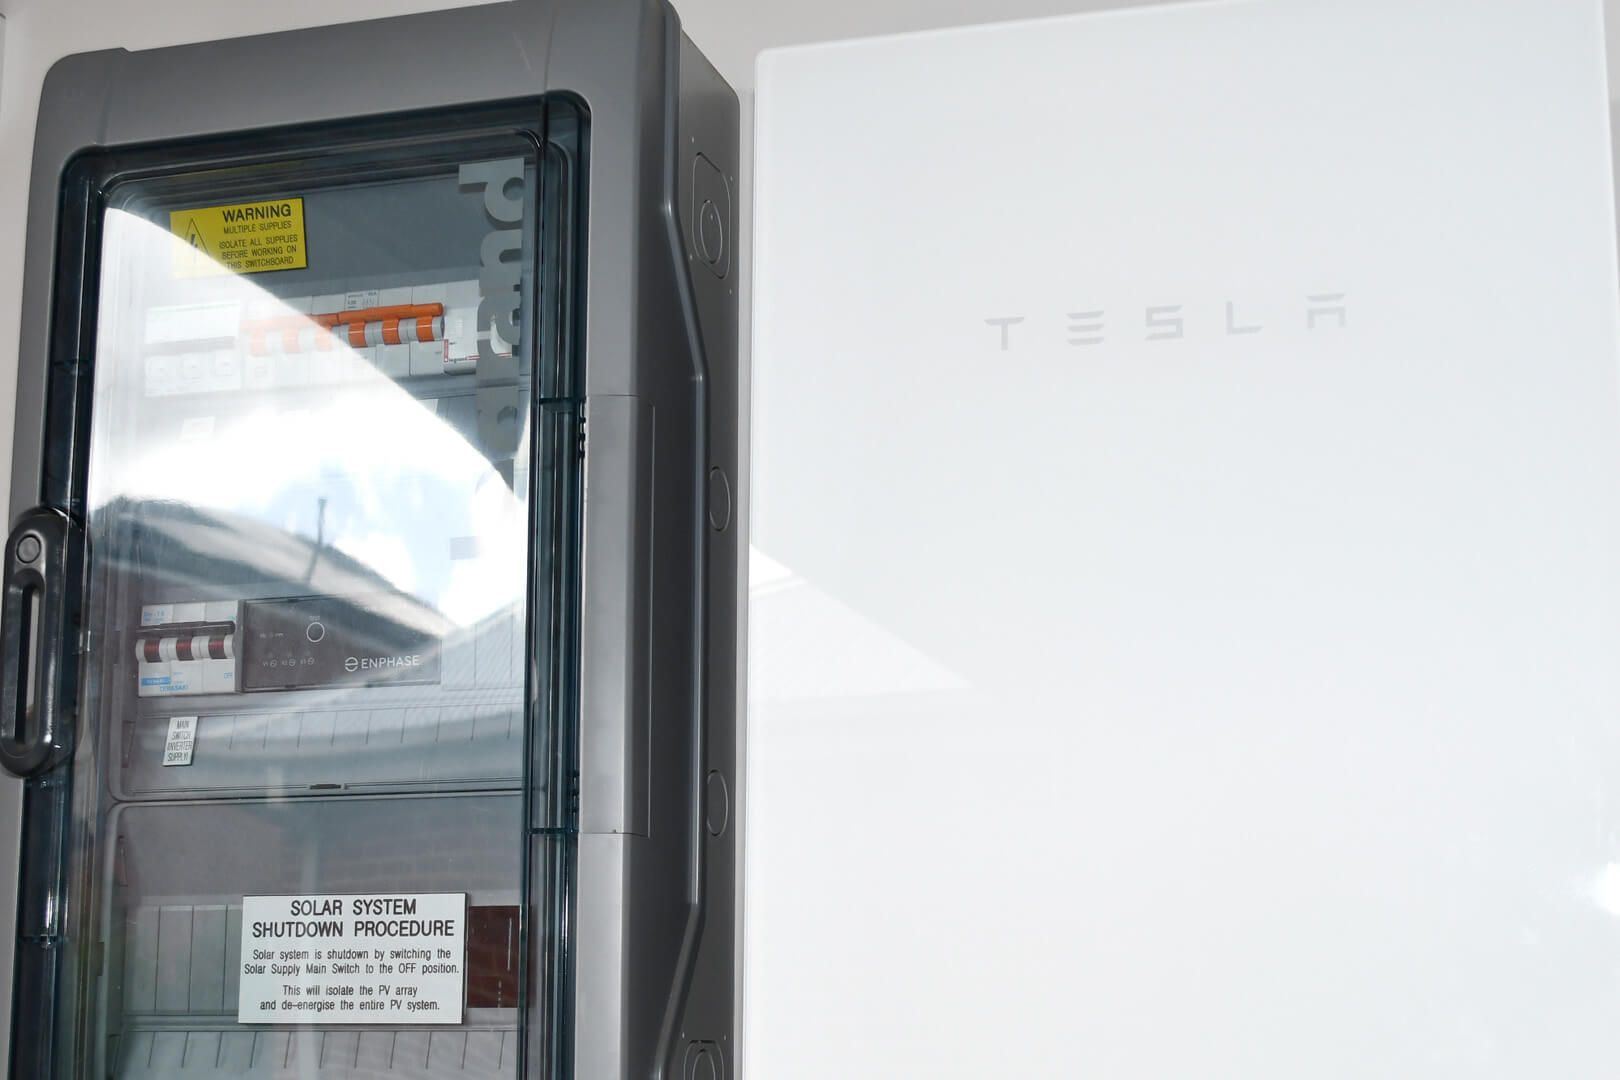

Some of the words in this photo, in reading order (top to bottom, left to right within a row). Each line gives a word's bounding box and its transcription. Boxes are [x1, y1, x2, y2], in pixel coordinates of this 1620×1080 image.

[222, 203, 292, 223] WARNING
[223, 223, 257, 235] MULTIPLE
[259, 221, 292, 232] SUPPLIES
[219, 239, 247, 249] ISOLATE
[250, 237, 262, 246] ALL
[265, 234, 298, 245] SUPPLIES
[222, 249, 248, 260] BEFORE
[251, 246, 284, 257] WORKING
[286, 245, 297, 253] ON
[245, 256, 294, 268] SWITCHBOARD
[983, 292, 1347, 351] TESLA
[361, 655, 420, 669] ENPHASE
[290, 899, 343, 917] SOLAR
[352, 898, 417, 915] SYSTEM
[252, 921, 344, 938] SHUTDOWN
[354, 919, 455, 938] PROCEDURE
[252, 949, 275, 960] Solar
[280, 950, 309, 963] system
[314, 949, 322, 959] is
[327, 949, 369, 960] shutdown
[374, 949, 385, 962] by
[390, 948, 432, 962] switching
[437, 948, 451, 959] the
[244, 964, 266, 975] Solar
[271, 964, 301, 977] Supply
[306, 963, 327, 974] Main
[331, 963, 360, 974] Switch
[365, 963, 374, 974] to
[379, 963, 393, 974] the
[398, 963, 417, 974] OFF
[422, 963, 459, 976] position.
[282, 984, 302, 996] This
[306, 984, 320, 995] will
[325, 984, 354, 996] isolate
[359, 984, 373, 995] the
[378, 984, 390, 995] PV
[395, 986, 418, 998] array
[260, 999, 277, 1011] and
[281, 999, 335, 1012] de-energise
[340, 999, 354, 1010] the
[359, 999, 385, 1010] entire
[390, 999, 402, 1010] PV
[407, 999, 440, 1012] system.
